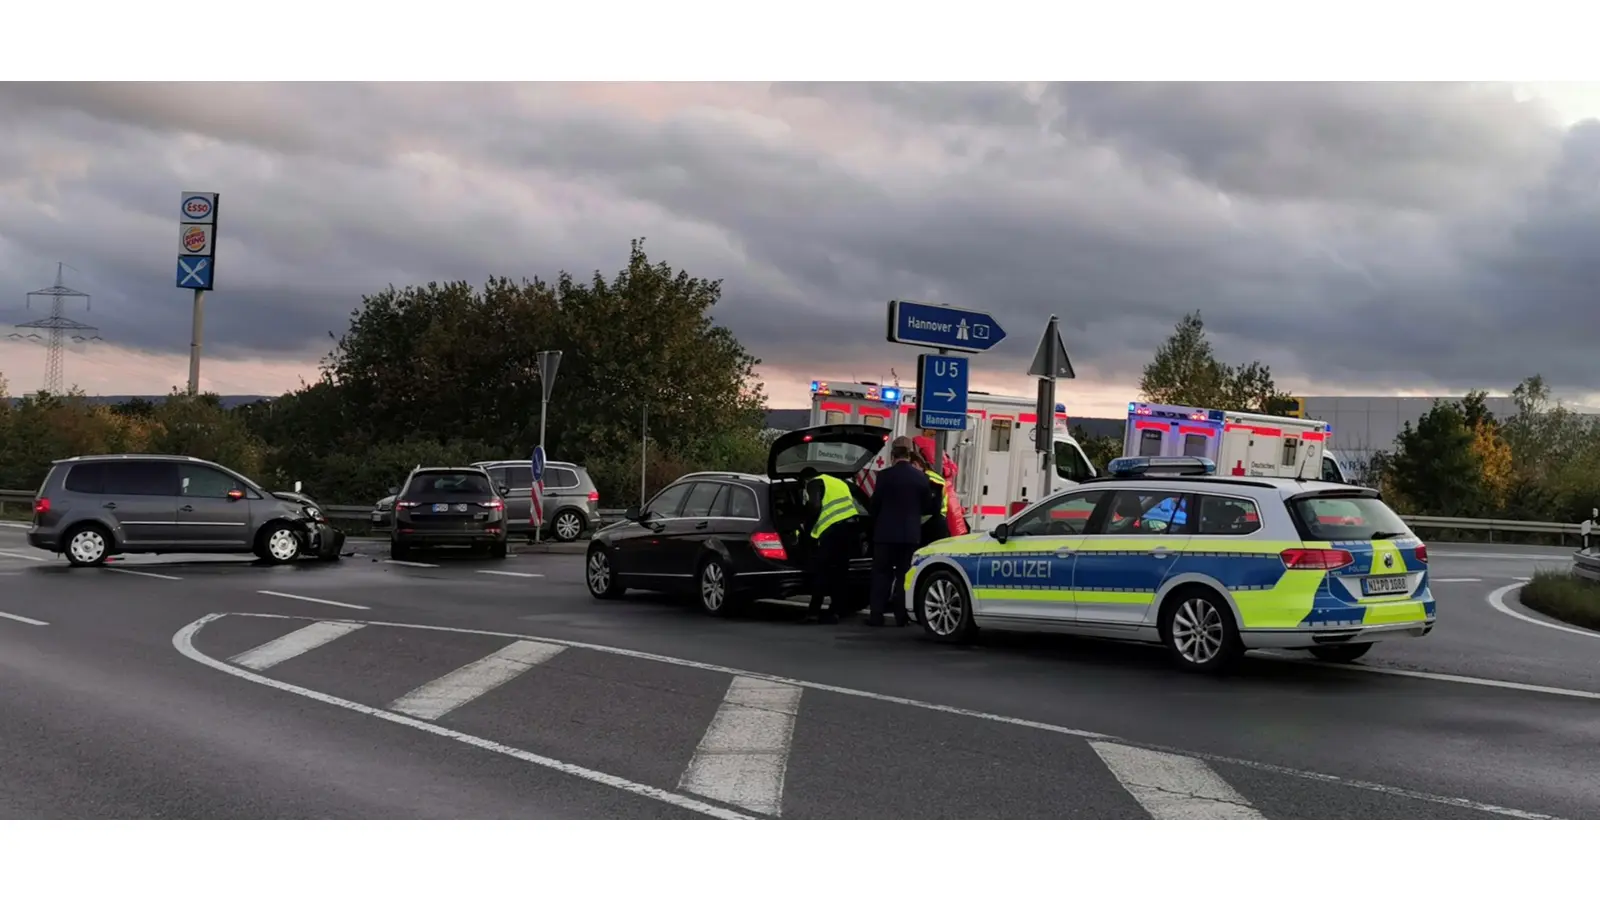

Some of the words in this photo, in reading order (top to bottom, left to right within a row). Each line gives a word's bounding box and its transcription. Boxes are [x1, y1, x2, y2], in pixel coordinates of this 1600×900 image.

[908, 316, 952, 333] Hannover
[935, 360, 946, 377] U
[949, 362, 958, 378] 5
[926, 414, 961, 426] Hannover
[991, 560, 1052, 578] POLIZEI
